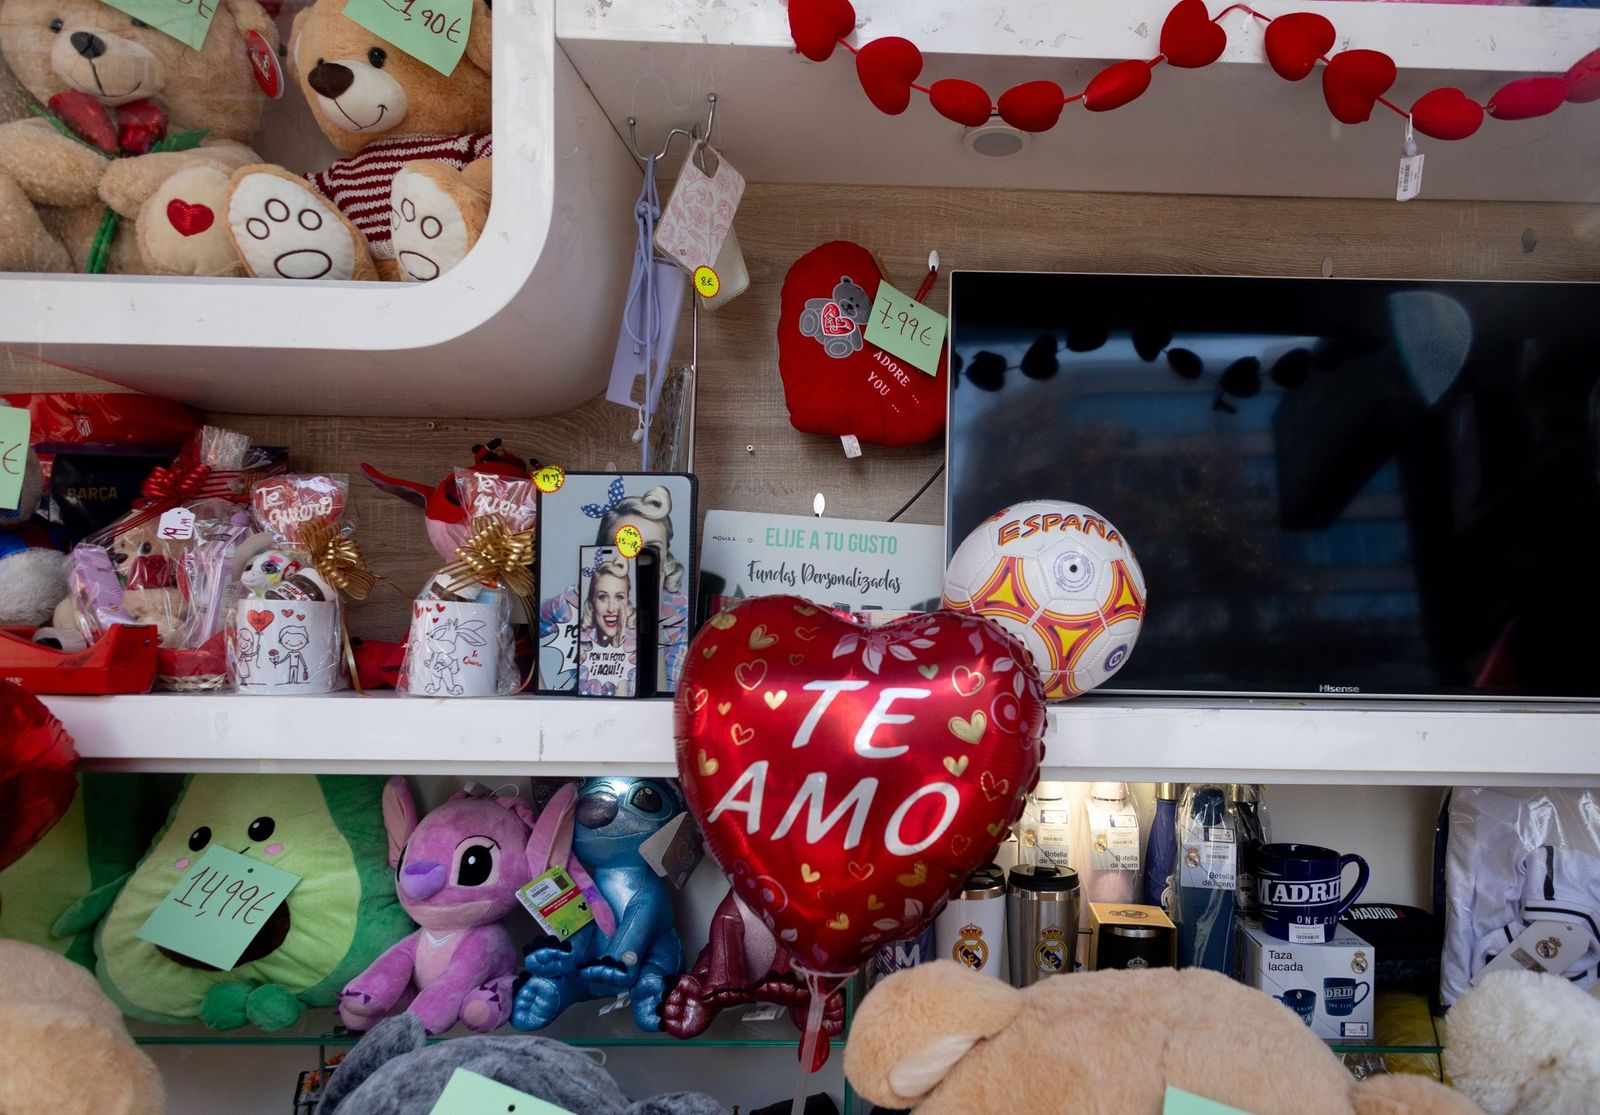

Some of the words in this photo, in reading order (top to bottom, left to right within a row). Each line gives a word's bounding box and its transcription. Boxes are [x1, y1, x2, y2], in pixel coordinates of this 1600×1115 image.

[880, 297, 931, 346] 7,99€
[873, 351, 910, 387] ADORE
[867, 371, 891, 396] YOU
[67, 487, 118, 502] BARÇA
[256, 485, 285, 510] Te
[765, 528, 805, 548] ELIJE
[809, 531, 819, 550] A
[825, 532, 844, 551] TU
[849, 533, 898, 555] GUSTO
[998, 513, 1123, 548] ESPAÑA
[747, 560, 798, 587] Fundas
[801, 563, 902, 594] Personalizadas
[565, 624, 579, 638] PO
[589, 652, 600, 661] PON
[602, 653, 608, 661] TU
[610, 653, 625, 662] FOTO
[1319, 684, 1360, 693] Hisense
[791, 679, 932, 759] TE
[707, 760, 960, 856] AMO
[1044, 850, 1067, 858] Botella
[174, 866, 275, 925] 14,99€
[1296, 915, 1319, 925] ONE
[1350, 907, 1398, 920] MADRID
[1268, 950, 1292, 960] Taza
[1268, 962, 1304, 972] lacada
